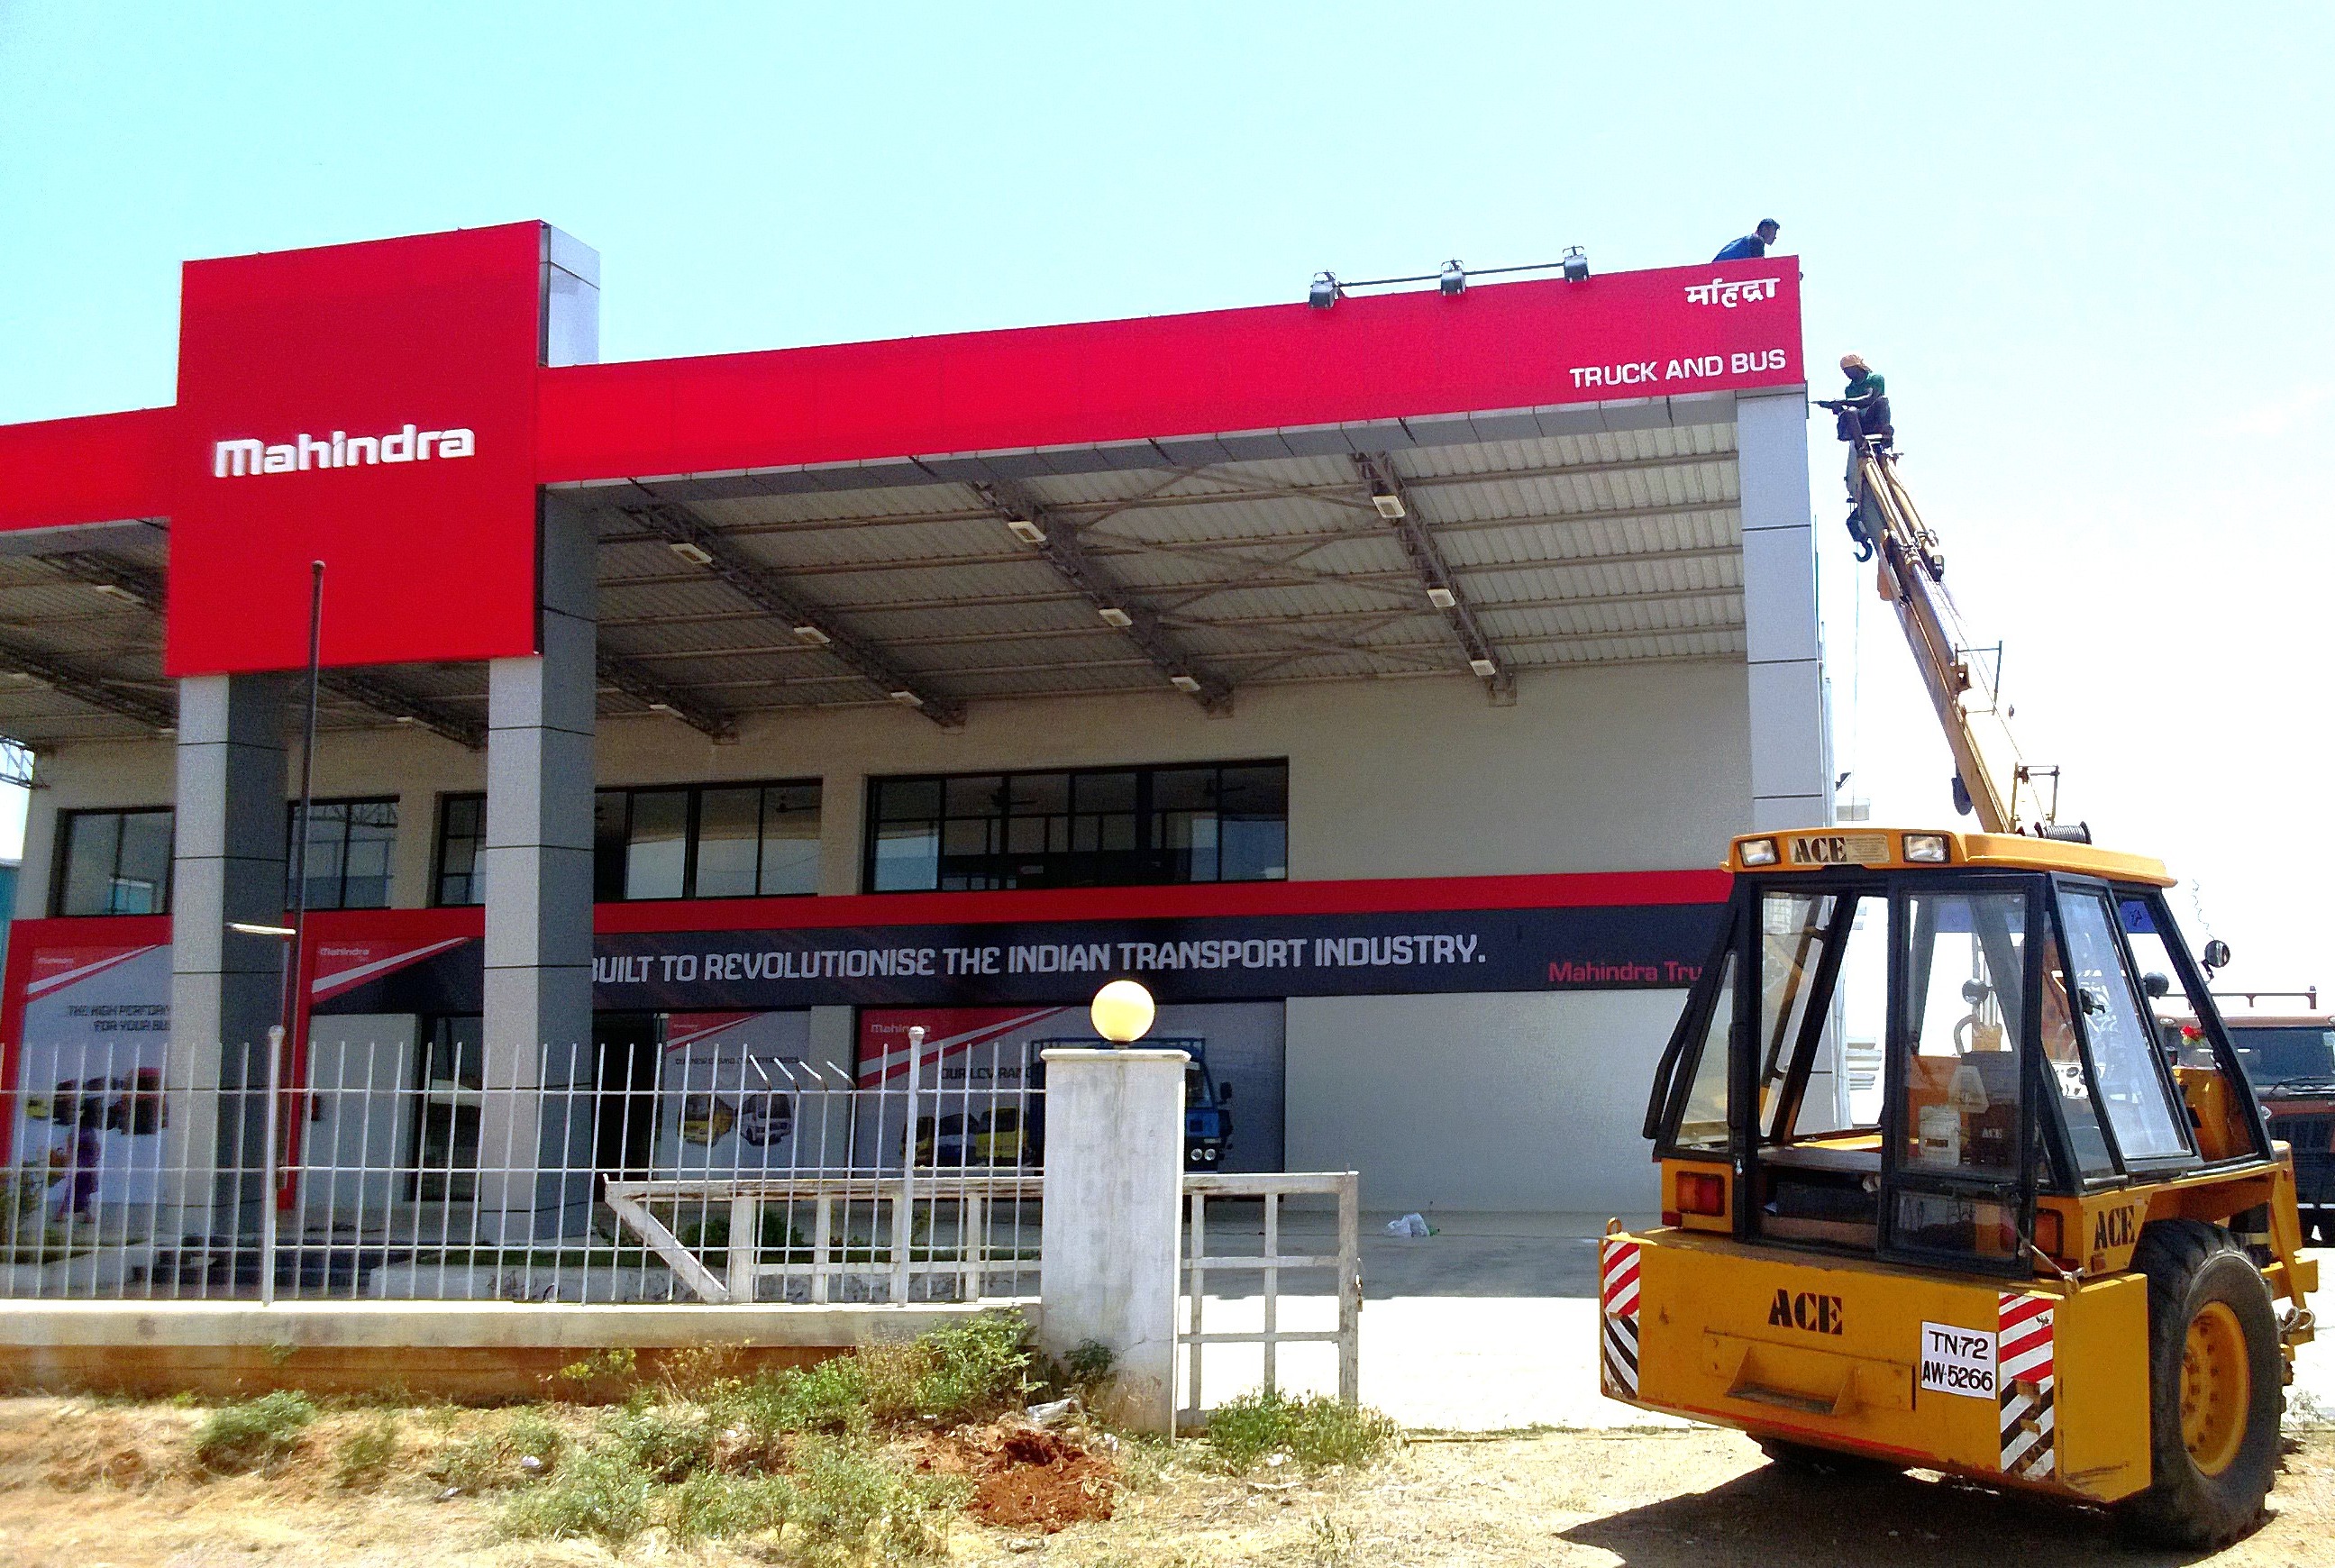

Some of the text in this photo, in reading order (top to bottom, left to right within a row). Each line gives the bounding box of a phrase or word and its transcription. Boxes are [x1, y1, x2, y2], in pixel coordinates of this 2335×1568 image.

[1569, 349, 1786, 388] TRUCK AND BUS
[214, 424, 476, 478] Mahindra
[1794, 836, 1847, 862] ACE
[660, 954, 698, 982] TO
[704, 948, 935, 981] REVOLUTIONISE
[943, 946, 1000, 975] THE
[1008, 943, 1110, 973] INDIAN
[1117, 937, 1308, 971] TRANSPORT
[1315, 934, 1487, 967] INDUSTRY.
[1548, 961, 1658, 983] Mahindra
[2093, 1205, 2136, 1251] ACE
[1767, 1289, 1843, 1336] ACE
